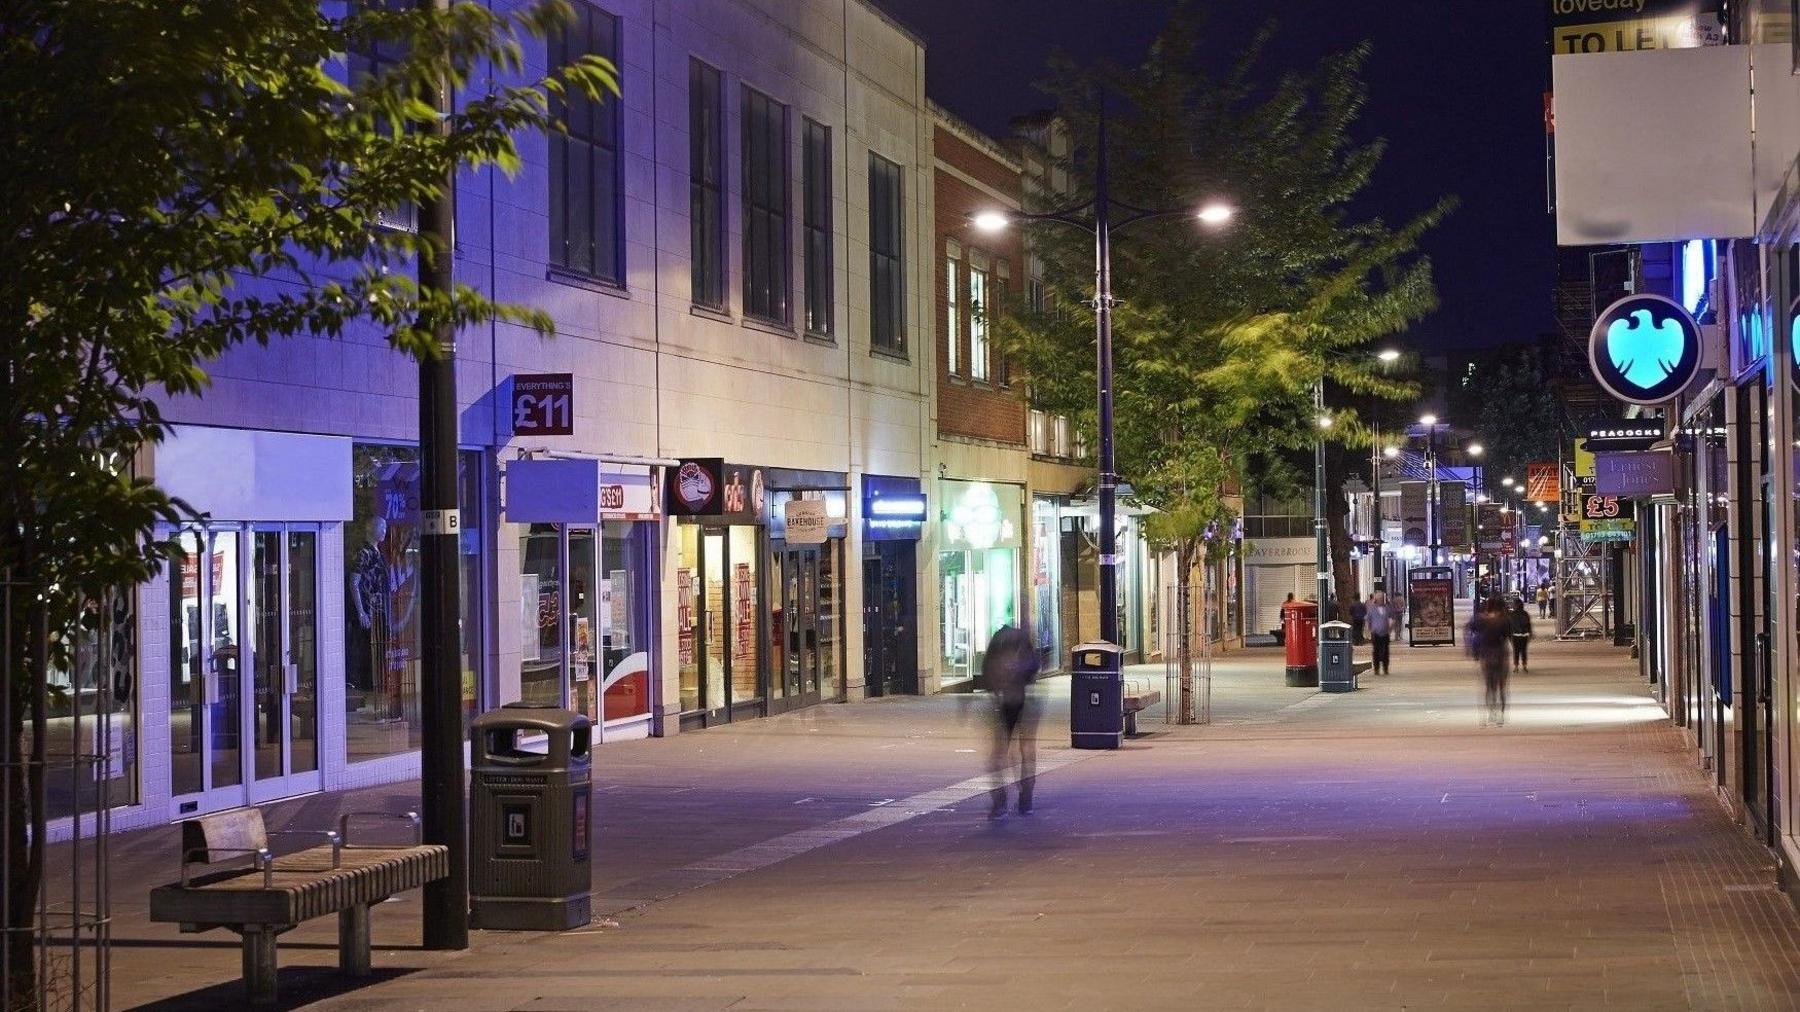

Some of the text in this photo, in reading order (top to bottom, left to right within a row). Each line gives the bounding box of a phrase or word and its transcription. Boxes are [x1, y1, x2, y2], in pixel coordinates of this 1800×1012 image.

[1553, 0, 1646, 15] loveday
[1563, 32, 1606, 54] TO
[514, 394, 569, 428] £11
[1590, 429, 1661, 438] PEACOCKS
[1586, 496, 1620, 518] £5
[449, 515, 458, 528] B
[679, 608, 692, 630] ALE
